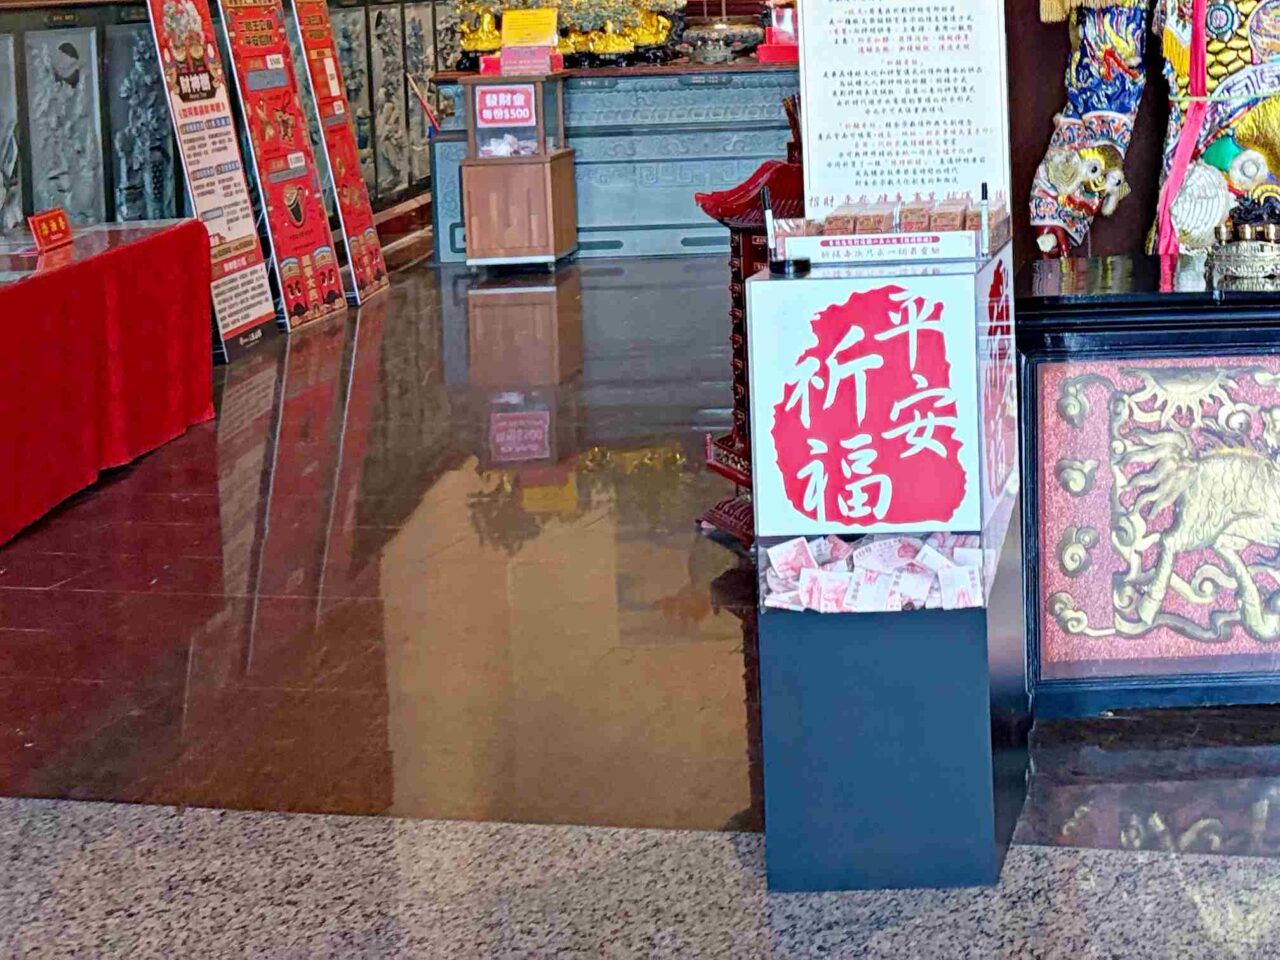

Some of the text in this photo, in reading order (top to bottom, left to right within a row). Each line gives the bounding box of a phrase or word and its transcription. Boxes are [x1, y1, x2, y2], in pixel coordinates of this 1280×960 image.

[482, 108, 530, 121] 每份$500
[485, 93, 525, 107] 發財金
[874, 290, 957, 459] 平安
[784, 325, 893, 521] 祈福
